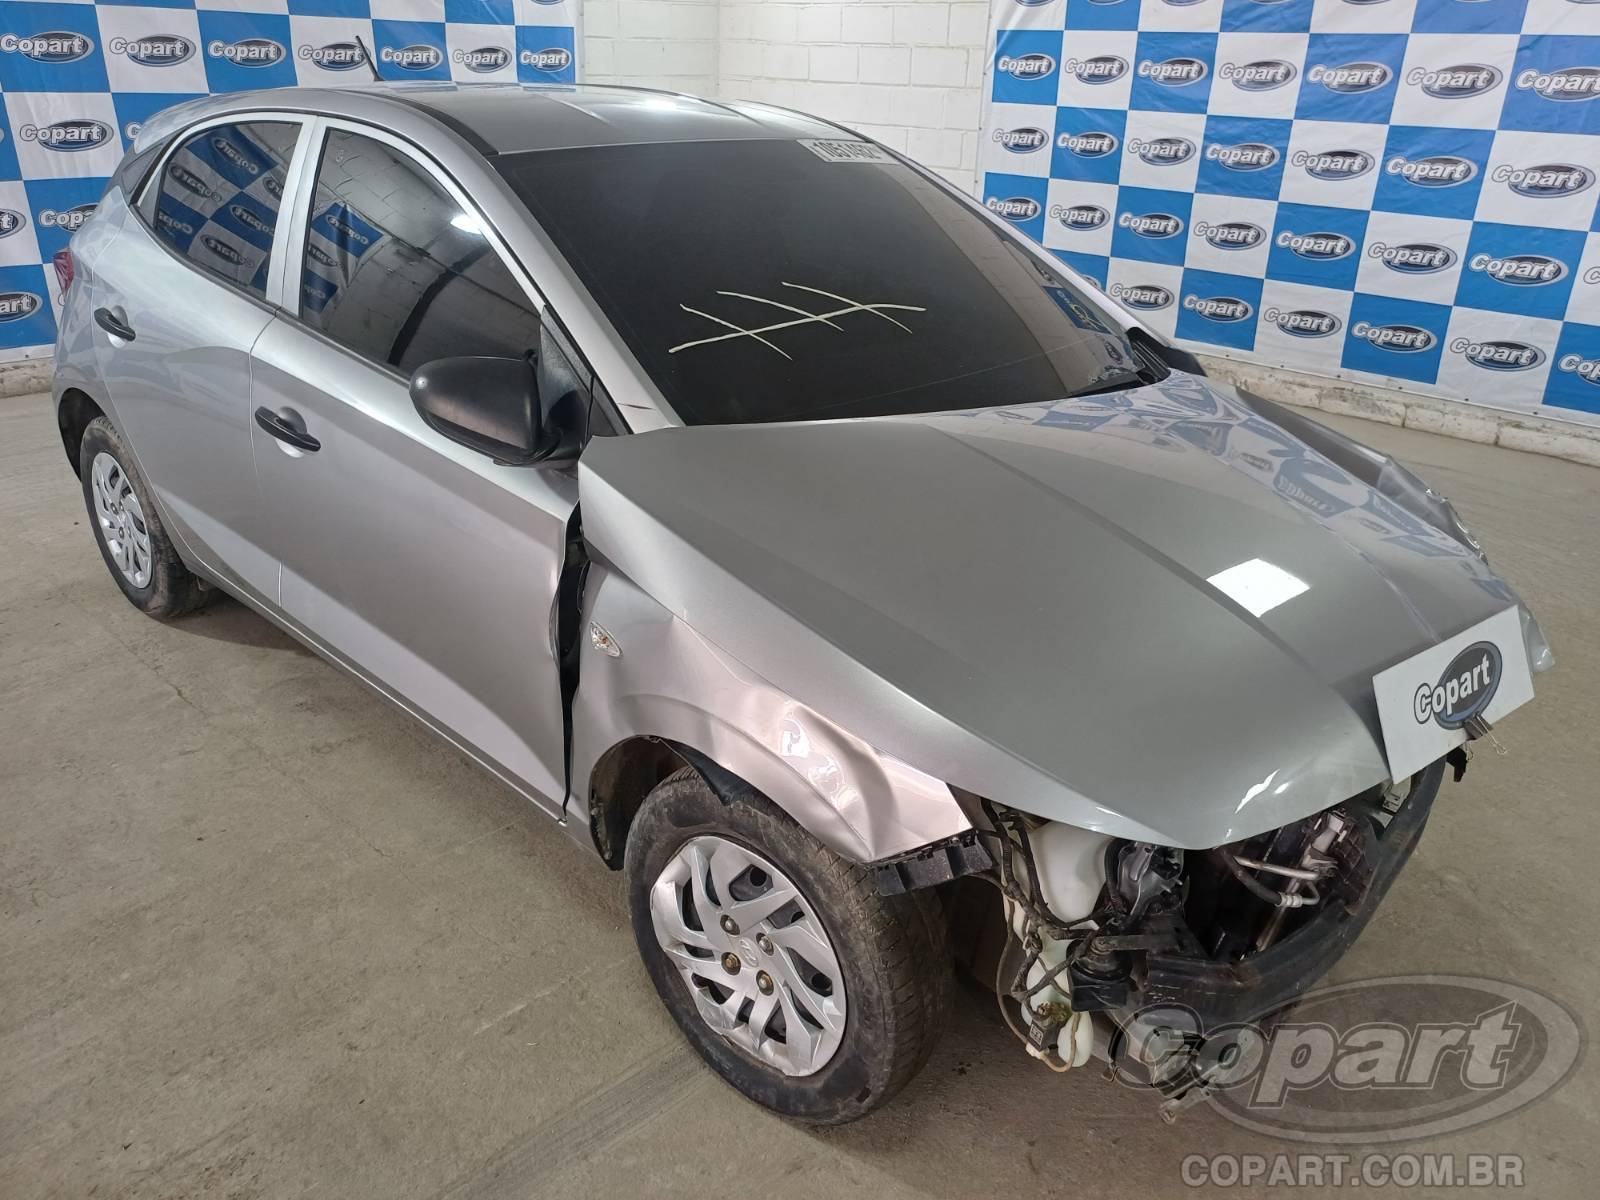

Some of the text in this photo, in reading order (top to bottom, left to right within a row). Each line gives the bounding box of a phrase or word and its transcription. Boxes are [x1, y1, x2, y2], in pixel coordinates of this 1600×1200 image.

[0, 33, 85, 58] Copart
[109, 37, 184, 60] Copart
[209, 40, 278, 61] Copart
[299, 45, 363, 62] Copart
[381, 46, 437, 64] Copart
[453, 49, 505, 67] Copart
[519, 49, 568, 69] Copart
[998, 56, 1049, 76] Copart
[1065, 58, 1121, 77] Copart
[1138, 60, 1200, 80] Copart
[1219, 63, 1288, 84] Copart
[1307, 64, 1384, 87] Copart
[1405, 67, 1493, 91] Copart
[19, 124, 102, 143] Copart
[992, 127, 1042, 147] Copart
[1057, 132, 1114, 152] Copart
[1128, 137, 1187, 159] Copart
[1206, 143, 1273, 166] Copart
[1291, 150, 1366, 173] Copart
[1386, 155, 1469, 180] Copart
[1491, 164, 1585, 191] Copart
[987, 196, 1035, 217] Copart
[1050, 203, 1103, 225] Copart
[40, 208, 95, 231] Cop
[1118, 212, 1177, 234] Copart
[1194, 221, 1257, 244] Copart
[1276, 231, 1347, 255] Copart
[1368, 241, 1446, 267] Copart
[1469, 253, 1560, 280] Copart
[0, 294, 32, 314] art
[1110, 283, 1167, 307] Copart
[1183, 295, 1248, 320] Copart
[1265, 307, 1332, 334] Copart
[1352, 321, 1429, 348] Copart
[1450, 338, 1535, 365] Copart
[1559, 355, 1600, 379] Cop
[1414, 652, 1491, 724] Copart
